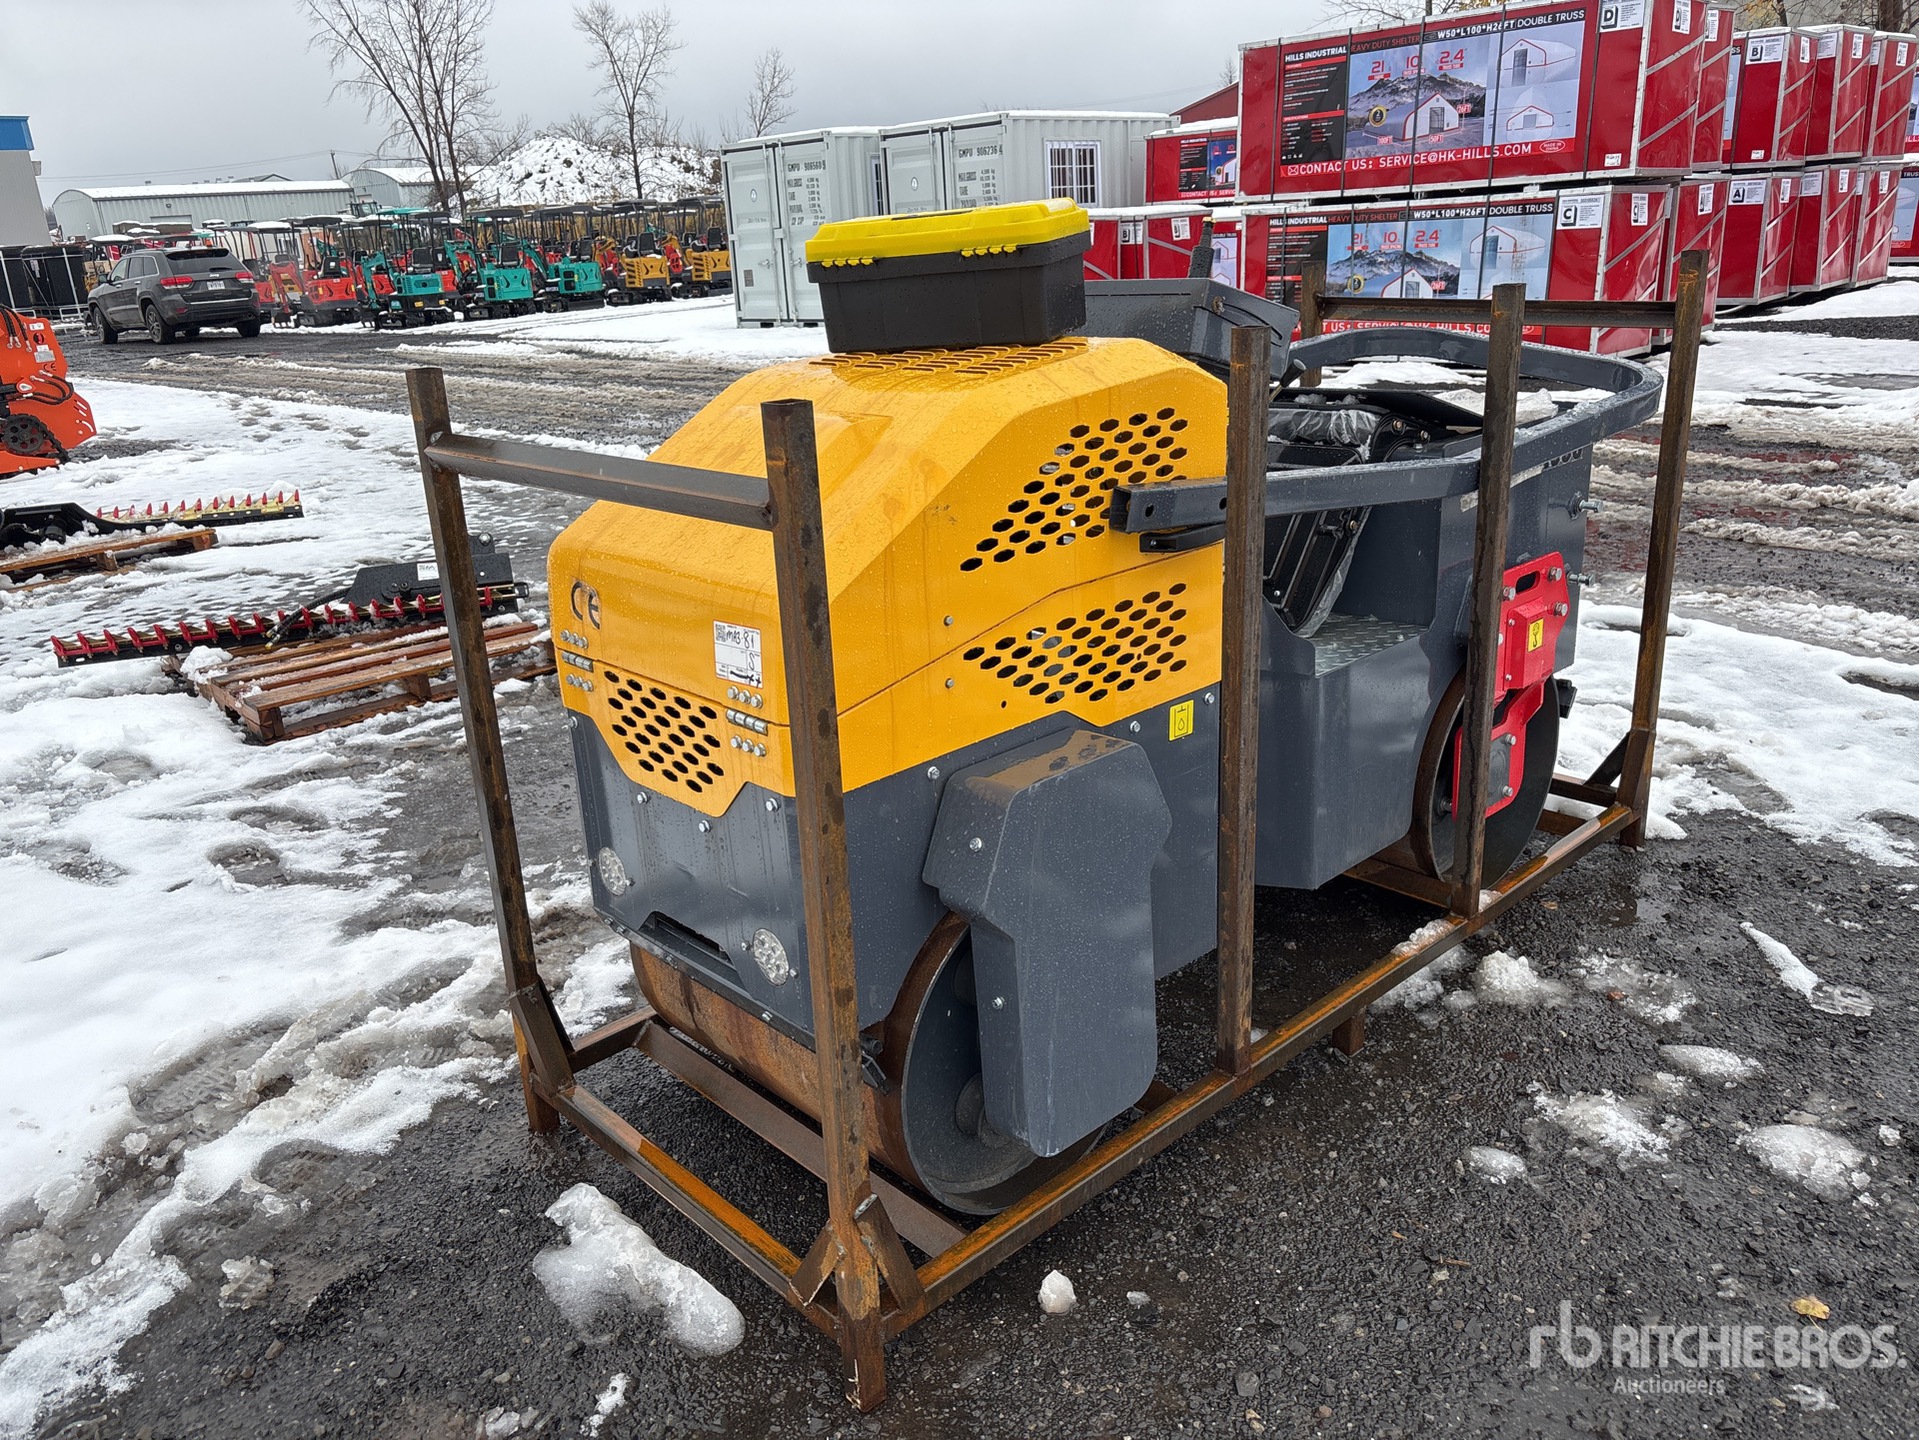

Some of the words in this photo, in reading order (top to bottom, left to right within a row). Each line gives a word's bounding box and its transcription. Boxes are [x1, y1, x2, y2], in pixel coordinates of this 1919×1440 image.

[1604, 10, 1614, 22] D
[1285, 52, 1303, 62] HILLS
[1305, 46, 1347, 60] INDUSTRIAL
[1350, 43, 1370, 52] EAVY
[1371, 40, 1390, 49] DUTY
[1391, 35, 1420, 47] SHELTER
[1517, 15, 1553, 27] DOUBLE
[1556, 10, 1585, 22] TRUSS
[1439, 49, 1464, 64] 2.4
[1371, 60, 1385, 74] 21
[1300, 160, 1348, 174] CONTACT
[1733, 188, 1742, 198] A
[1288, 216, 1328, 224] INDUSTRIAL
[1370, 212, 1398, 220] SHELTER
[1489, 205, 1522, 215] DOUBLE
[1525, 203, 1553, 212] TRUSS
[1563, 208, 1573, 220] C
[1383, 232, 1398, 242] 10
[1416, 230, 1439, 242] 2.4
